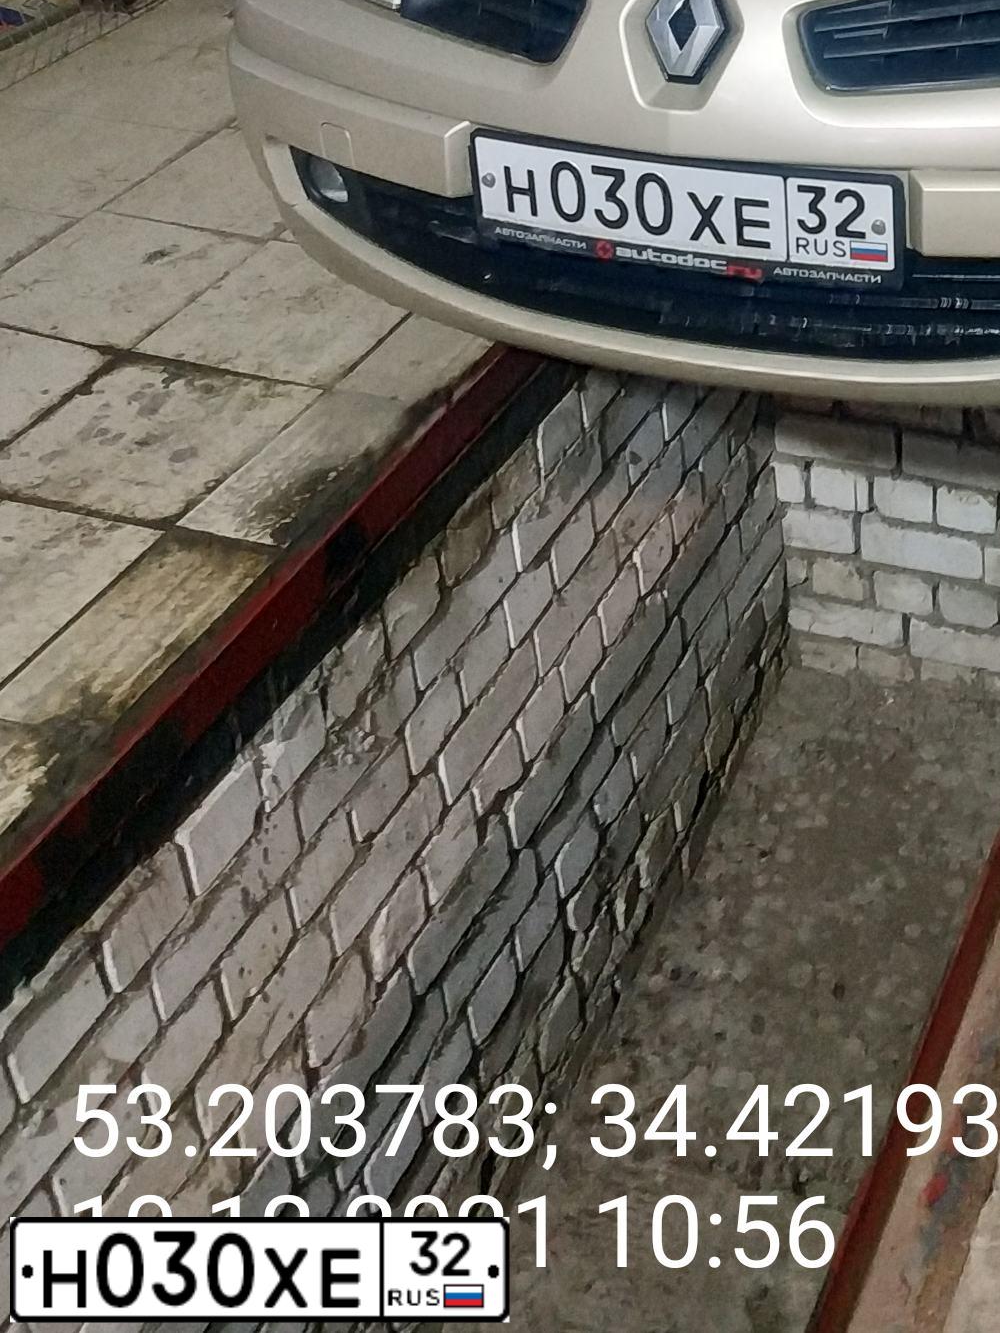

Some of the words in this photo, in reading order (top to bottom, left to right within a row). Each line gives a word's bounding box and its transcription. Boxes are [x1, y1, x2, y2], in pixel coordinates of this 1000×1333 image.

[503, 160, 772, 249] Н030ХЕ
[797, 184, 866, 239] 32
[493, 226, 588, 249] АВТОЗАПЧАСТИ
[795, 237, 846, 257] RUS
[773, 266, 882, 284] АВТОЗАПЧАСТИ
